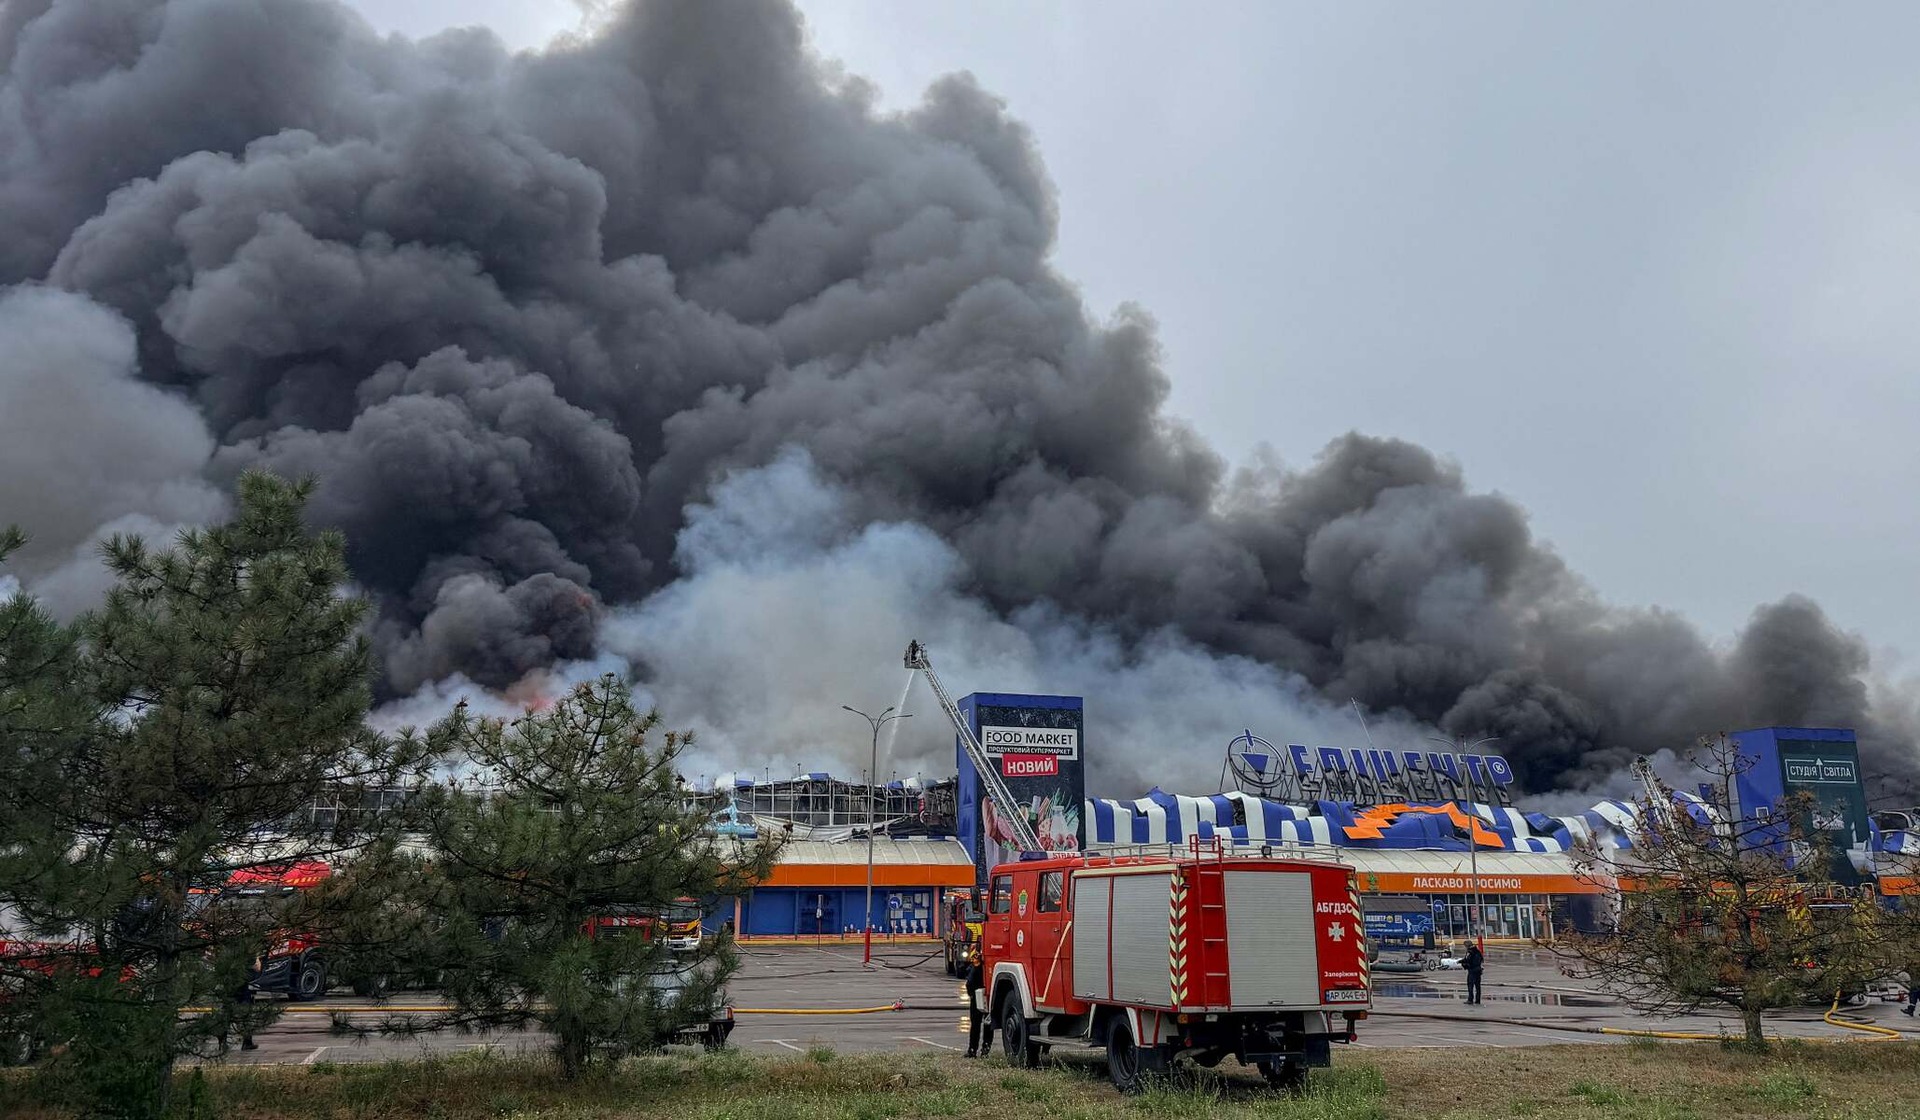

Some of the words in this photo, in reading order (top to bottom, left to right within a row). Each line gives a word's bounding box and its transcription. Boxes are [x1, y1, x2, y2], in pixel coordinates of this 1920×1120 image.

[986, 731, 1022, 743] FOOD
[1026, 733, 1073, 745] MARKET
[988, 746, 1030, 754] ПРОДУКТОВИЙ
[1030, 747, 1071, 755] СУПЕРМАРКЕТ
[1007, 757, 1054, 774] НОВИЙ
[1789, 765, 1818, 777] СТУДІЯ
[1823, 766, 1852, 777] СВІТЛА
[1413, 877, 1464, 888] ЛАСКАВО
[1316, 901, 1353, 915] АБГДЗС
